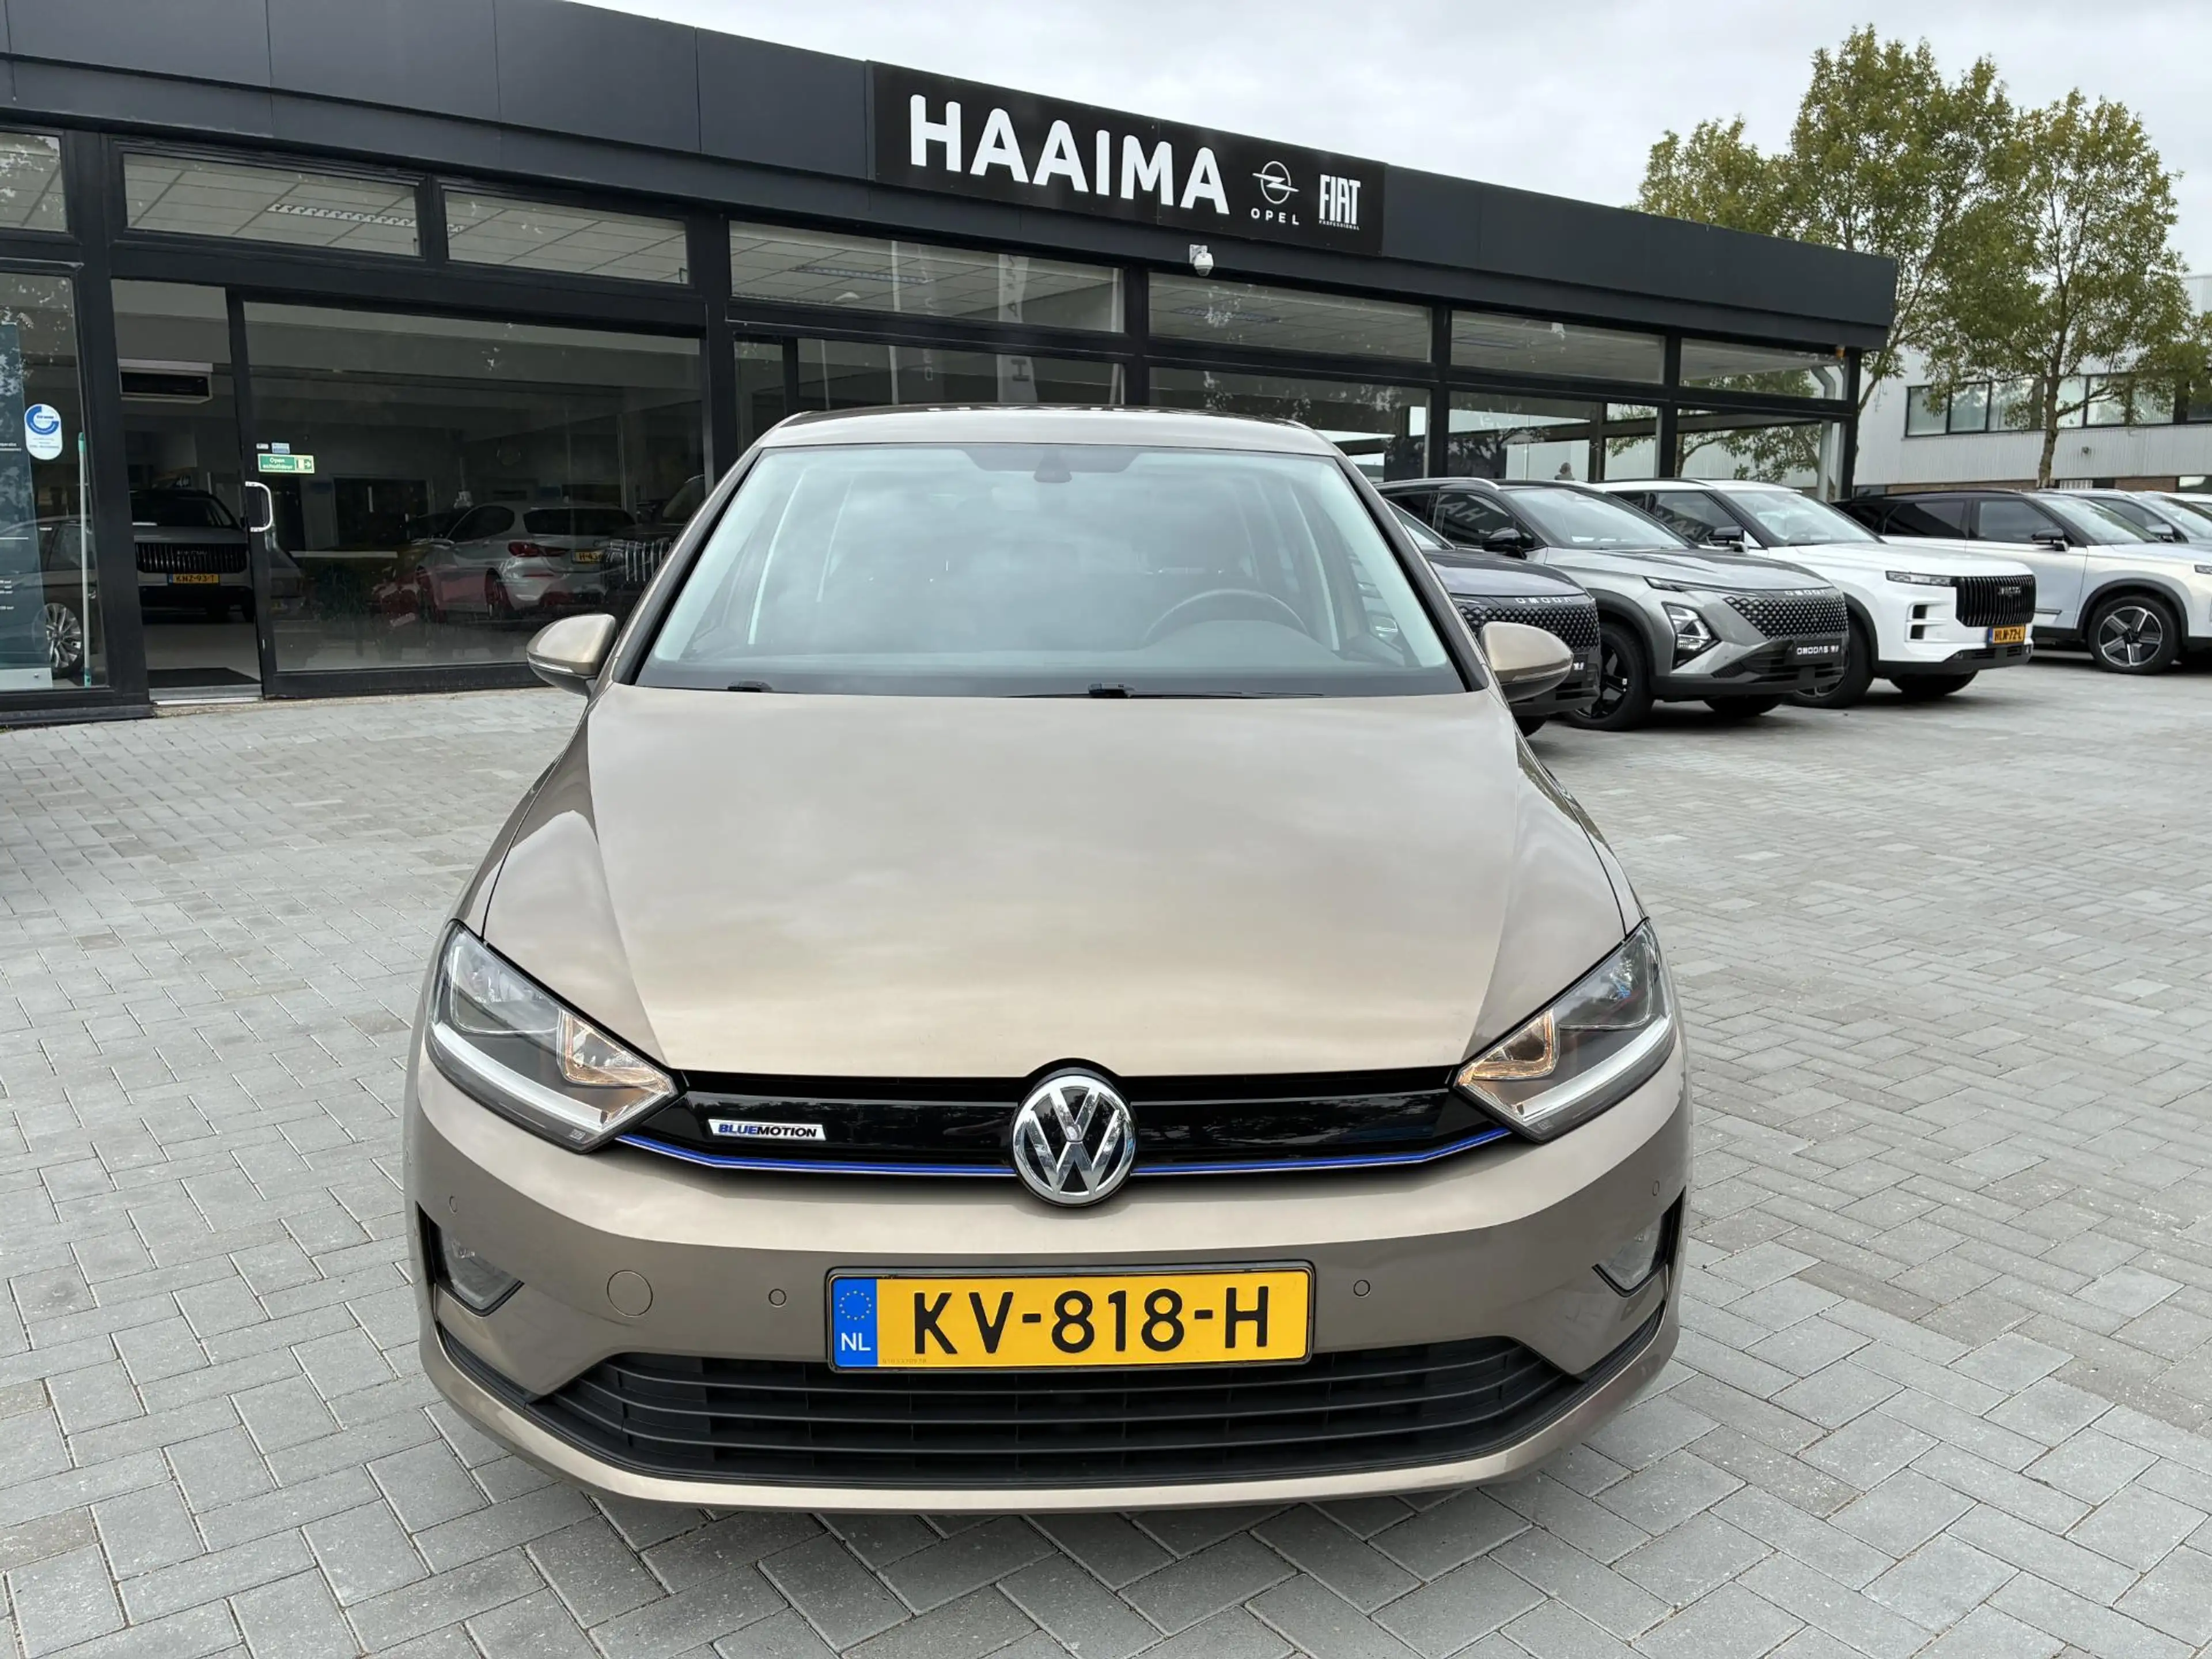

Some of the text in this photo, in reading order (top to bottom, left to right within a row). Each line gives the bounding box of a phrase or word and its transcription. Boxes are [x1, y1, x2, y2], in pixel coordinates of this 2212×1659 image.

[910, 94, 1230, 215] HAAIMA
[1250, 207, 1300, 225] OPEL
[1319, 174, 1361, 225] FIAT
[719, 1124, 817, 1137] BLUEMOTION
[841, 1286, 1268, 1355] NL KV-818-H
